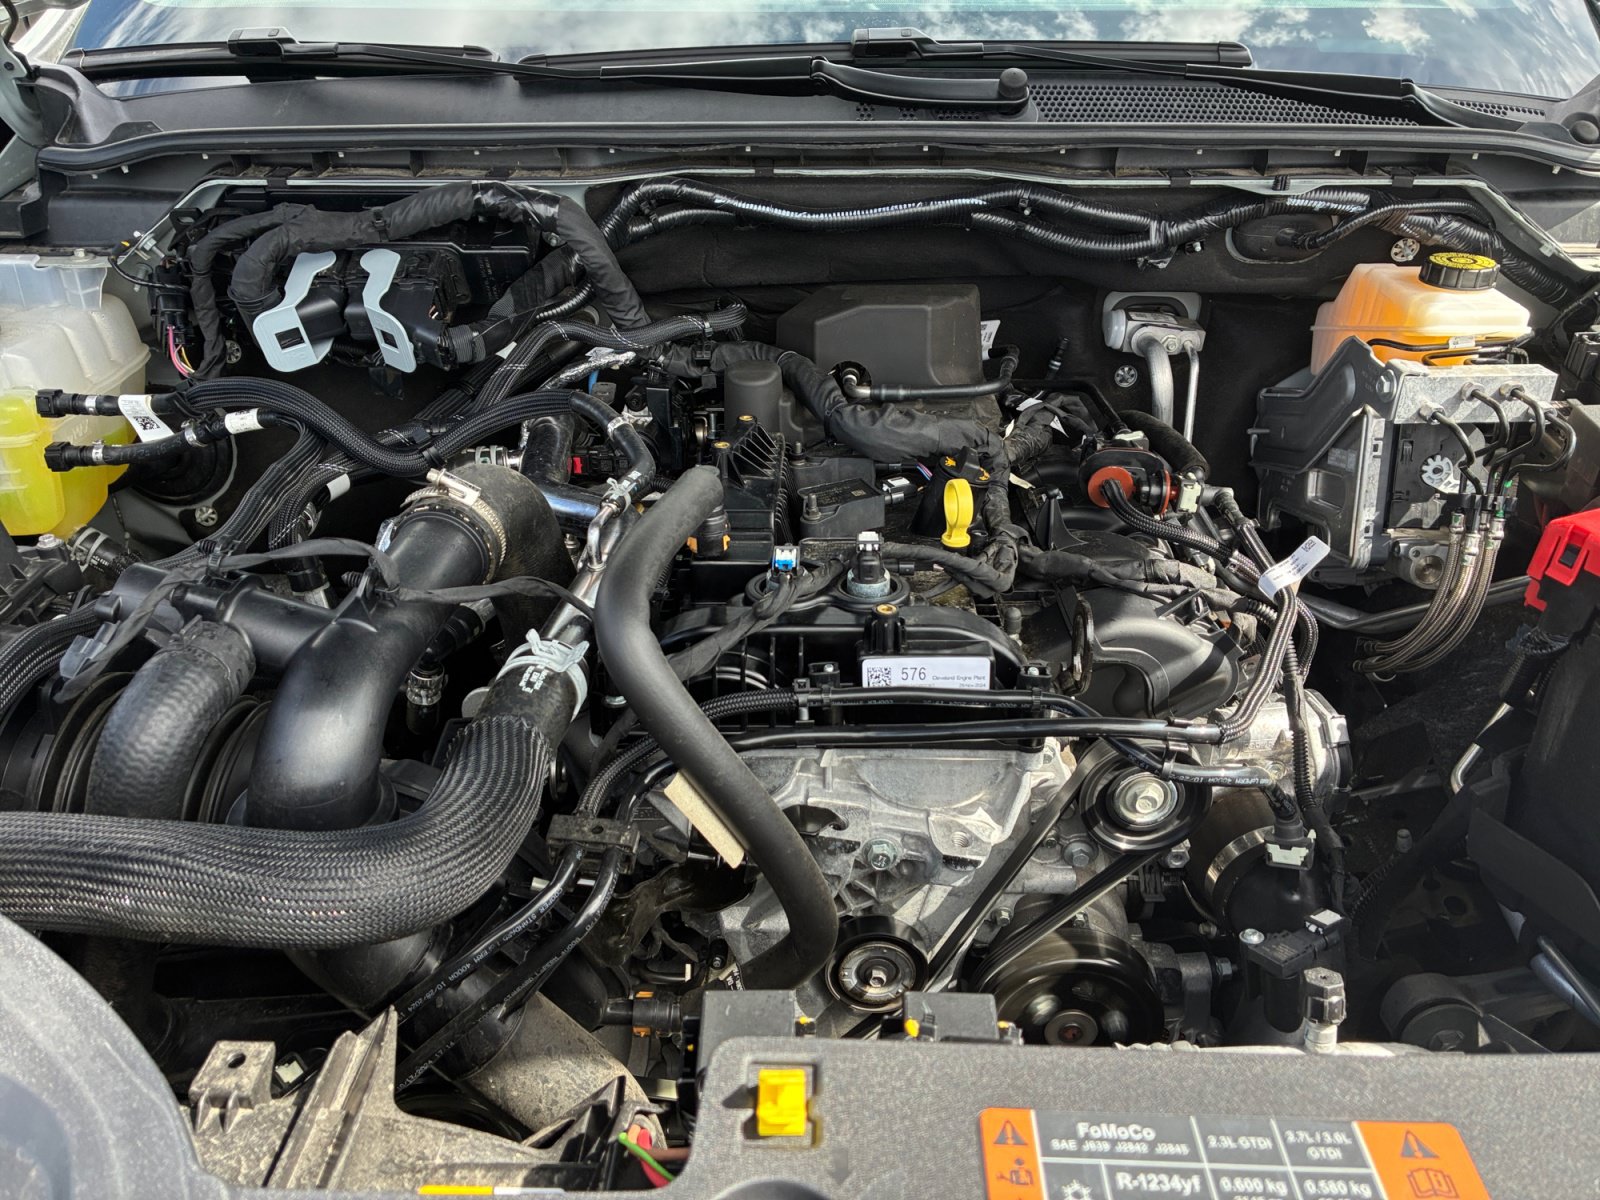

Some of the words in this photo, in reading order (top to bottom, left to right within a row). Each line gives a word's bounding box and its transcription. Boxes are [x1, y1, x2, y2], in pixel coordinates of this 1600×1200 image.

[901, 667, 927, 681] 576
[538, 887, 564, 914] COOPER
[448, 962, 472, 982] 4000A
[1076, 1122, 1157, 1141] FoMoCo
[1051, 1138, 1078, 1151] SAE
[1115, 1172, 1201, 1197] R-1234yf
[1219, 1176, 1264, 1193] 0.600
[1264, 1177, 1288, 1197] kg
[1348, 1180, 1373, 1199] kg
